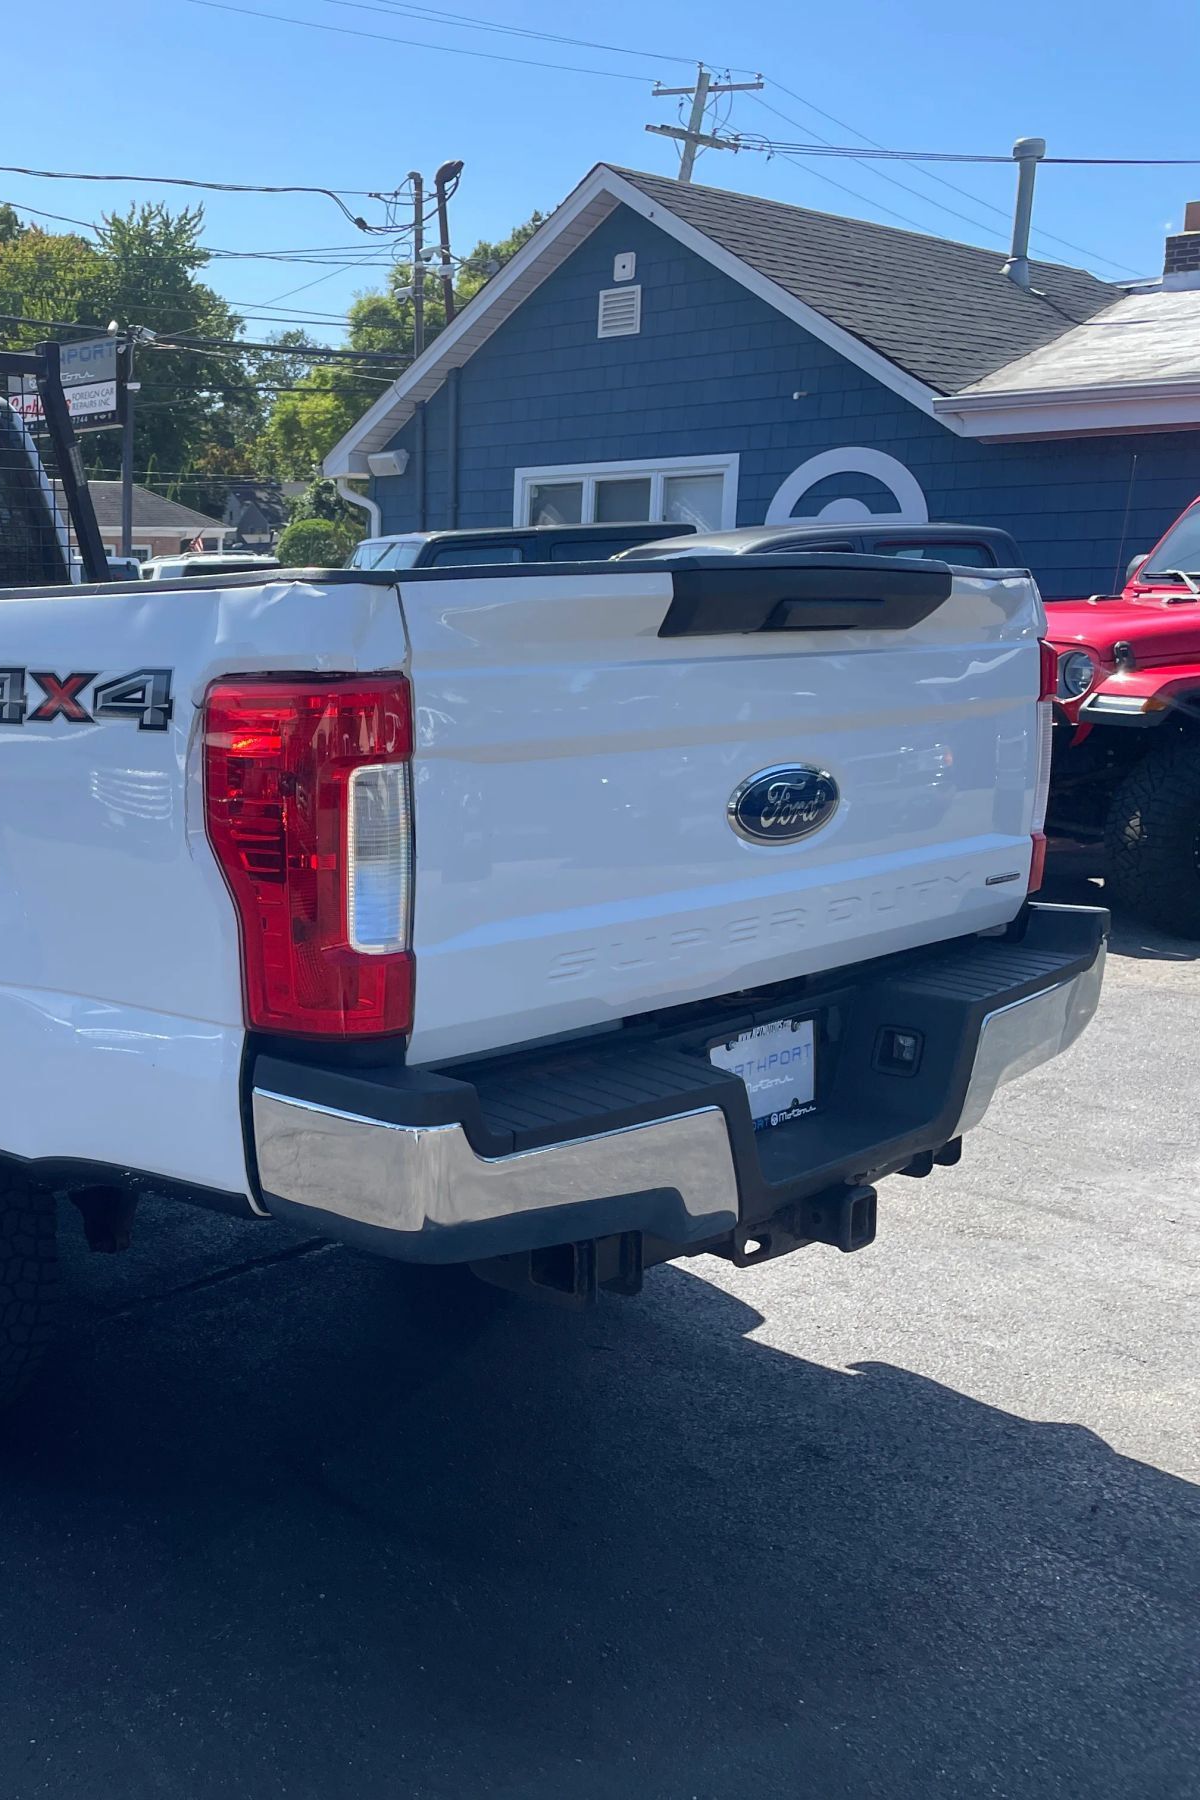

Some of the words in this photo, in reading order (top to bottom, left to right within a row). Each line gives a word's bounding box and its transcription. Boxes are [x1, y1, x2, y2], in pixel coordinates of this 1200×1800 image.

[71, 389, 100, 400] FOREIGN
[101, 386, 114, 397] CAR
[72, 399, 97, 411] REPAIRS
[98, 397, 111, 406] INC
[761, 780, 826, 828] Ford
[548, 907, 807, 982] SUPER
[826, 871, 972, 926] DUTY
[779, 1105, 816, 1122] Motors
